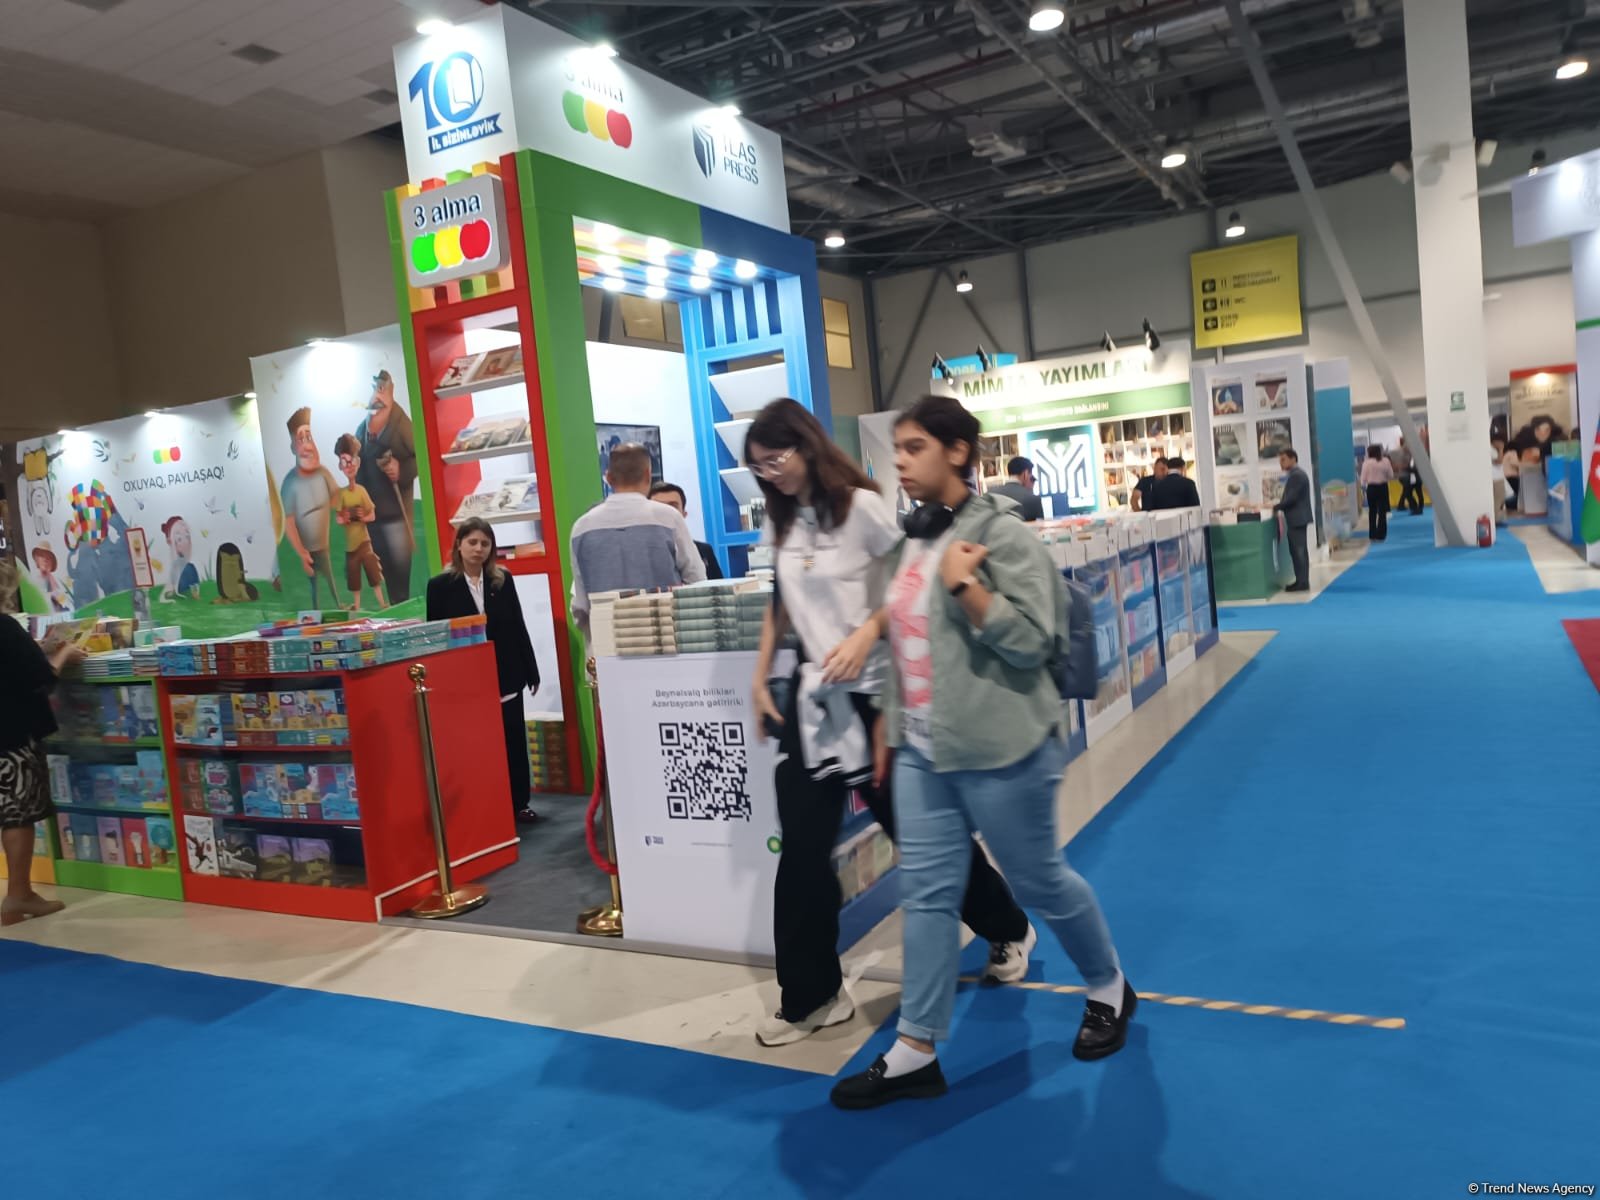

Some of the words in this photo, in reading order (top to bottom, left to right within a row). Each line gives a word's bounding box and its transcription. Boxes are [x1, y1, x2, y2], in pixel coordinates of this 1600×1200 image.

[723, 155, 759, 185] PRESS
[414, 205, 427, 229] 3
[431, 194, 483, 225] alma
[123, 475, 167, 492] OXUYAQ,
[168, 466, 225, 485] PAYLAŞAQ!
